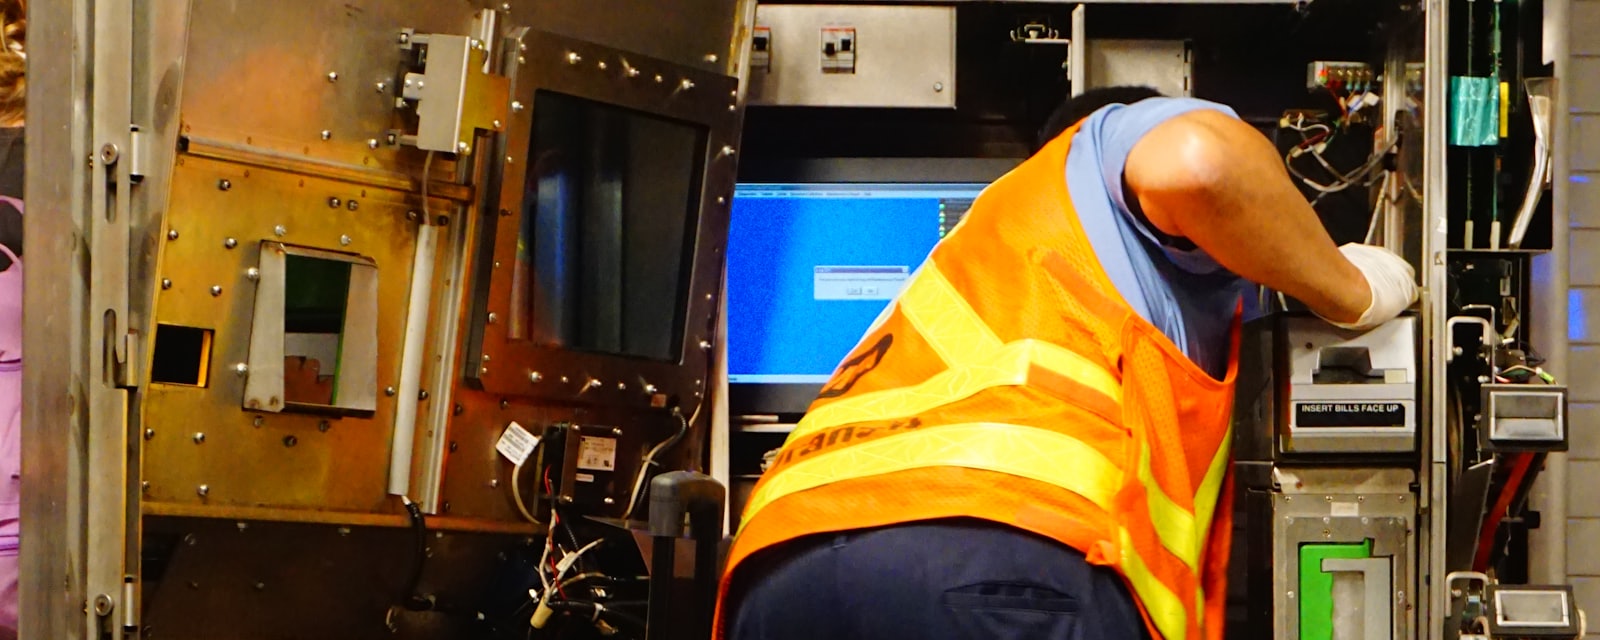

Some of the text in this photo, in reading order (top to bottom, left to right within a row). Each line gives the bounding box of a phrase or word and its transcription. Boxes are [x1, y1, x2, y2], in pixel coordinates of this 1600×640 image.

[1302, 404, 1399, 413] INSERT BILLS FACE UP
